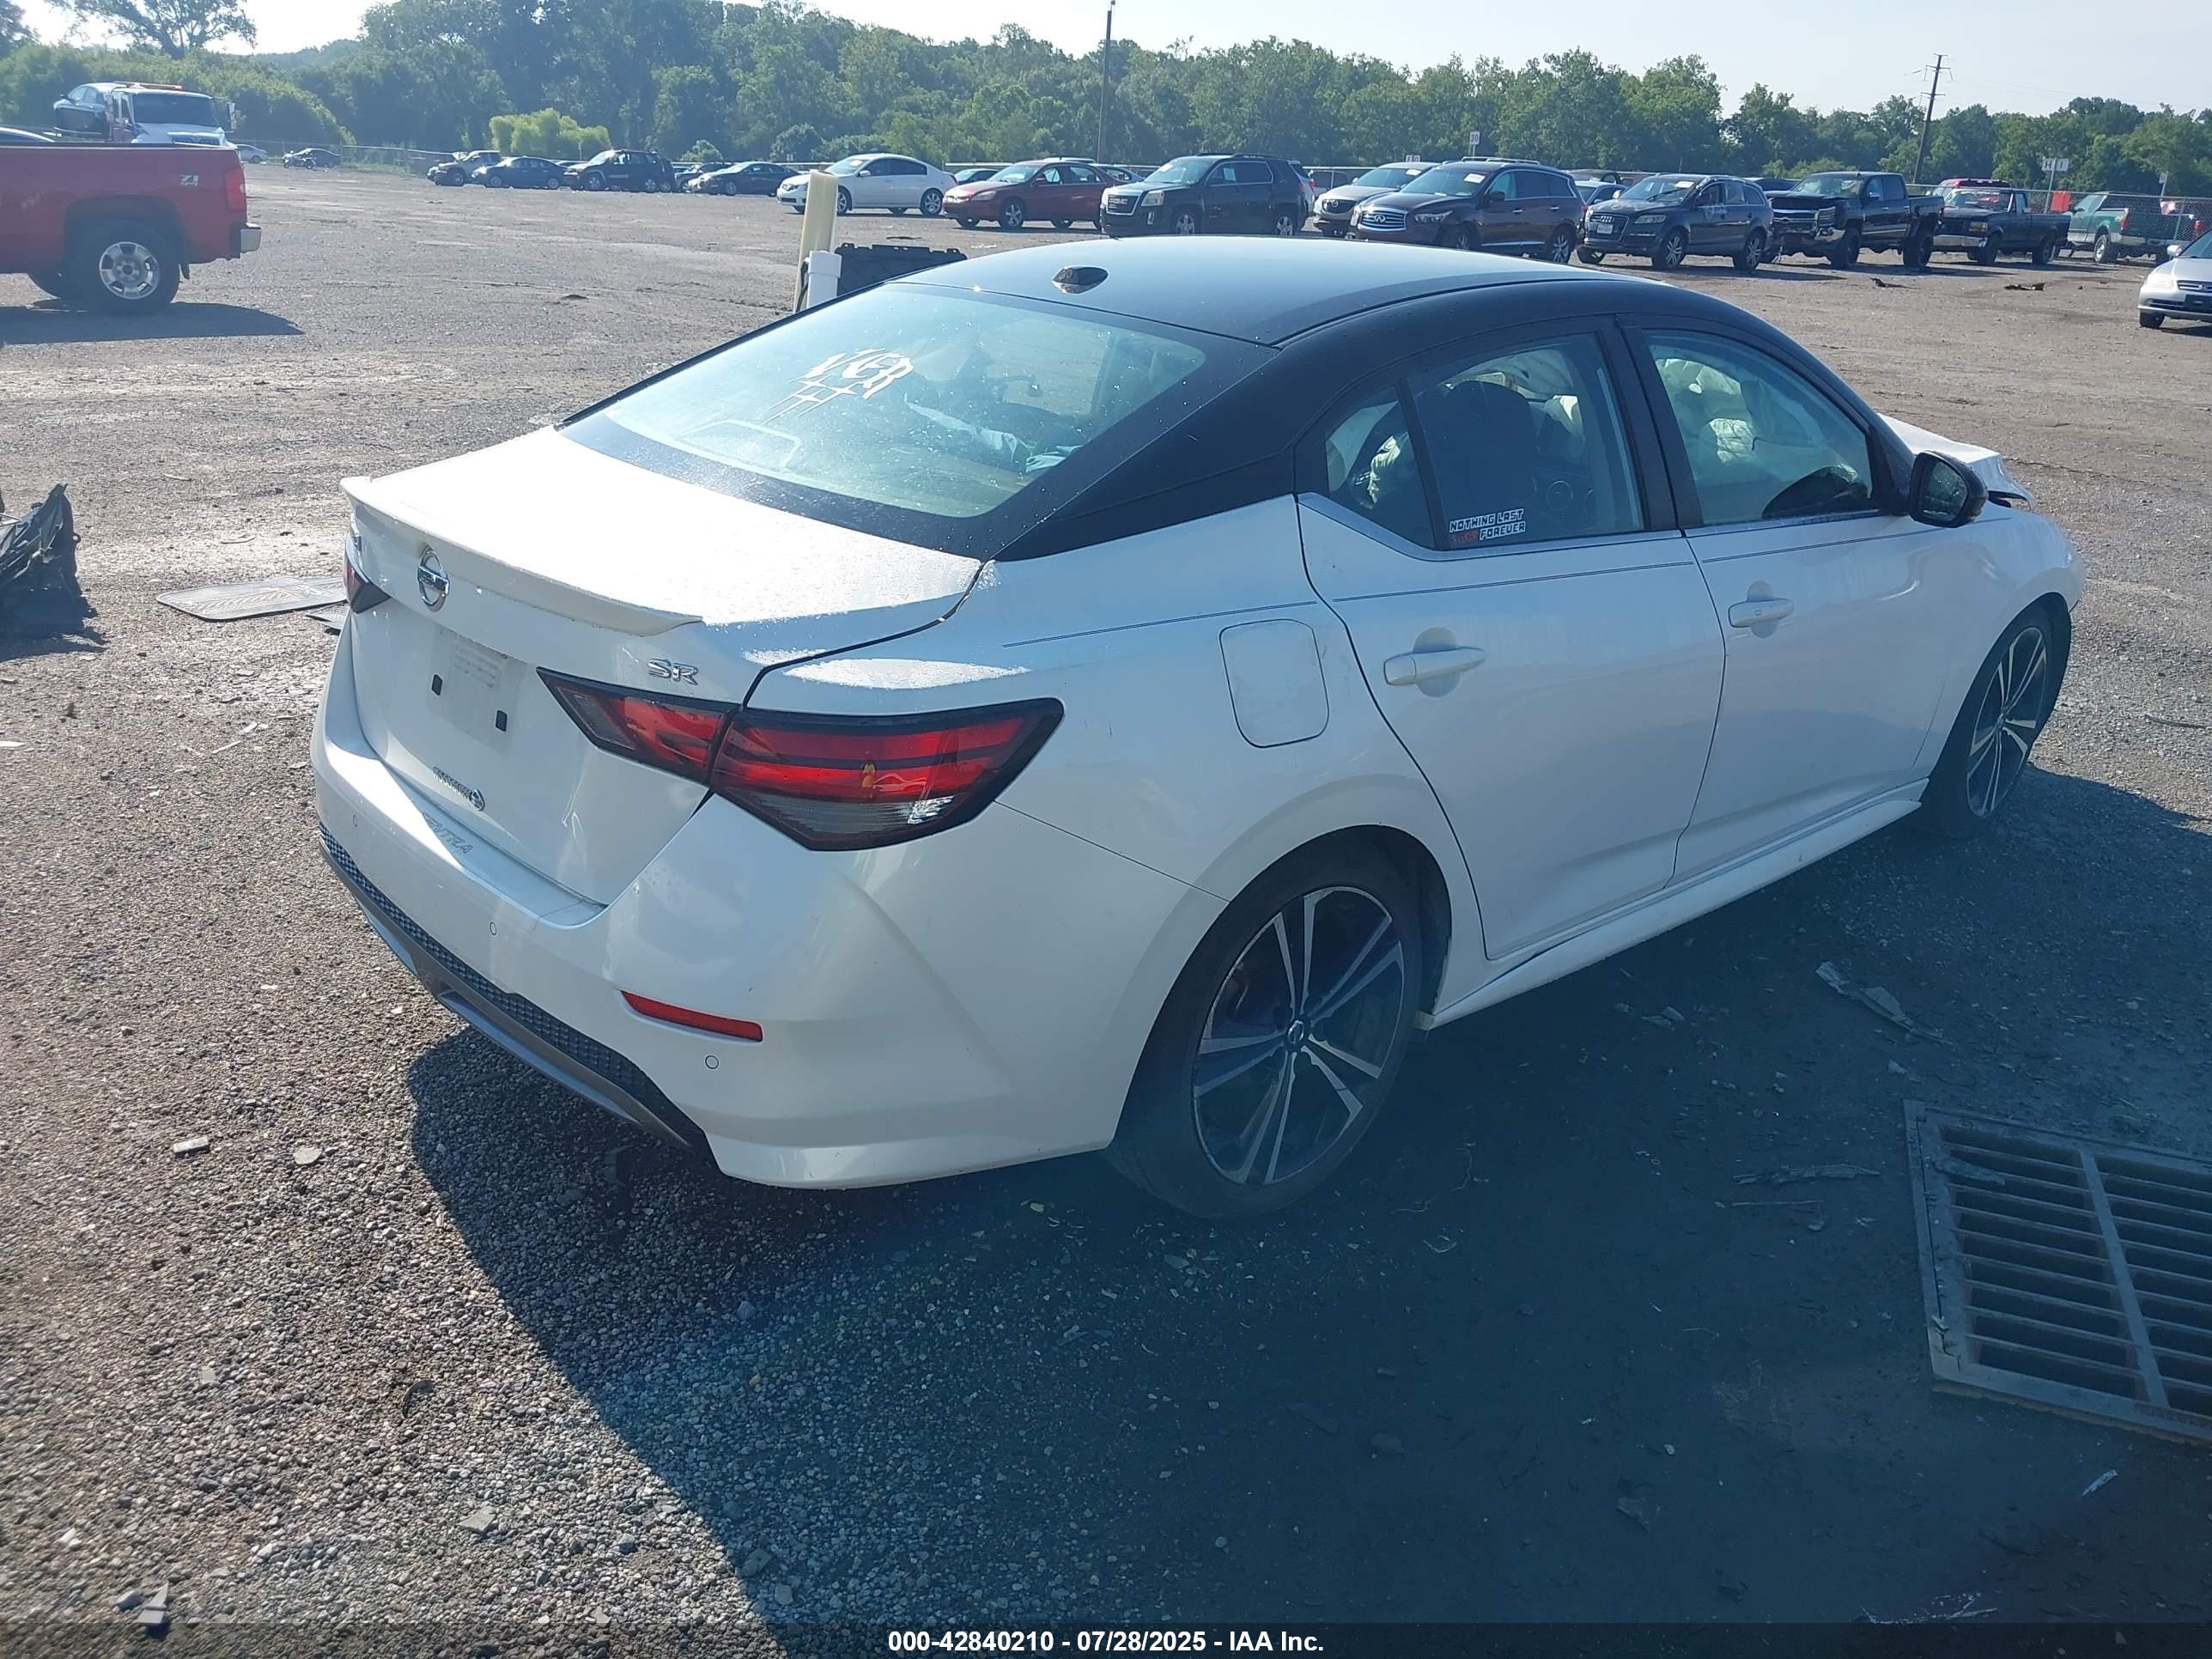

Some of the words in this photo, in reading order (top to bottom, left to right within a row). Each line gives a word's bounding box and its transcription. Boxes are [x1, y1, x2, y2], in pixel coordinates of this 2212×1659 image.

[1449, 514, 1496, 533] NOTHING
[1497, 508, 1525, 524] LAST
[647, 659, 699, 686] SR
